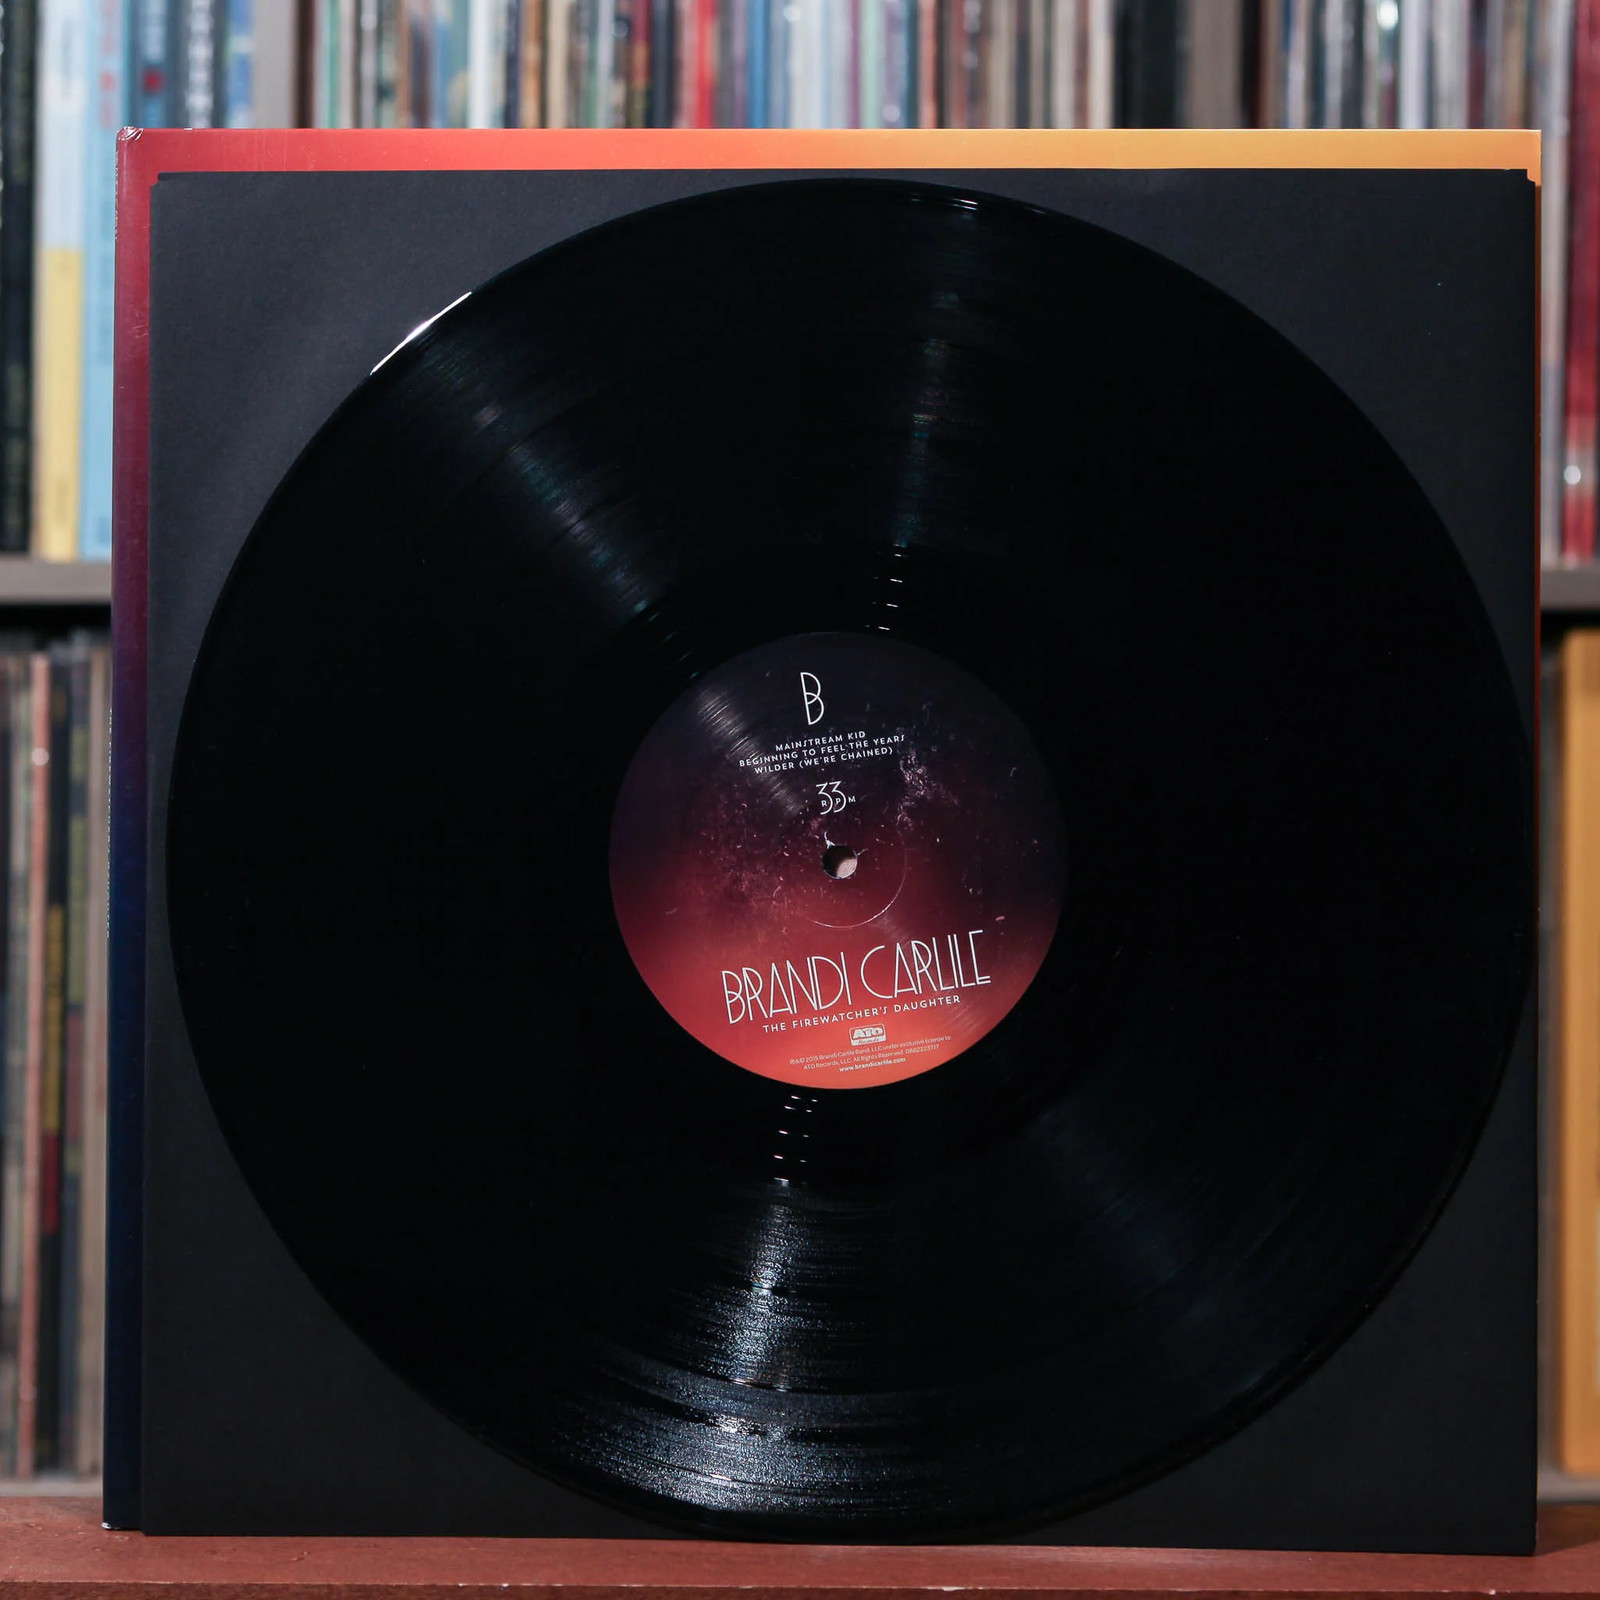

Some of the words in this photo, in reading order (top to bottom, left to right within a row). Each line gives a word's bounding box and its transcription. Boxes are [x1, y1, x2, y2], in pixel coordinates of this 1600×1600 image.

[800, 671, 825, 726] B
[739, 752, 799, 768] BEGINNING
[803, 748, 816, 757] TO
[821, 743, 846, 755] FEEL
[849, 739, 869, 750] THE
[873, 734, 905, 746] YEARS
[775, 734, 843, 752] MAINSTREAM
[848, 730, 866, 740] KID
[754, 762, 795, 774] WILDER
[799, 755, 836, 769] (WE'RE
[841, 747, 893, 761] CHAINED)
[816, 780, 847, 815] 33
[721, 951, 852, 1024] BRANDI
[860, 929, 992, 1000] CARLILE
[763, 1022, 787, 1033] THE
[792, 1006, 888, 1029] FIREWATCHER'S
[894, 995, 961, 1013] DAUGHTER
[819, 1052, 837, 1060] Brandi
[900, 1040, 924, 1048] exclusive
[839, 1058, 906, 1072] www.brandicarlile.com
[861, 1054, 877, 1062] Rights
